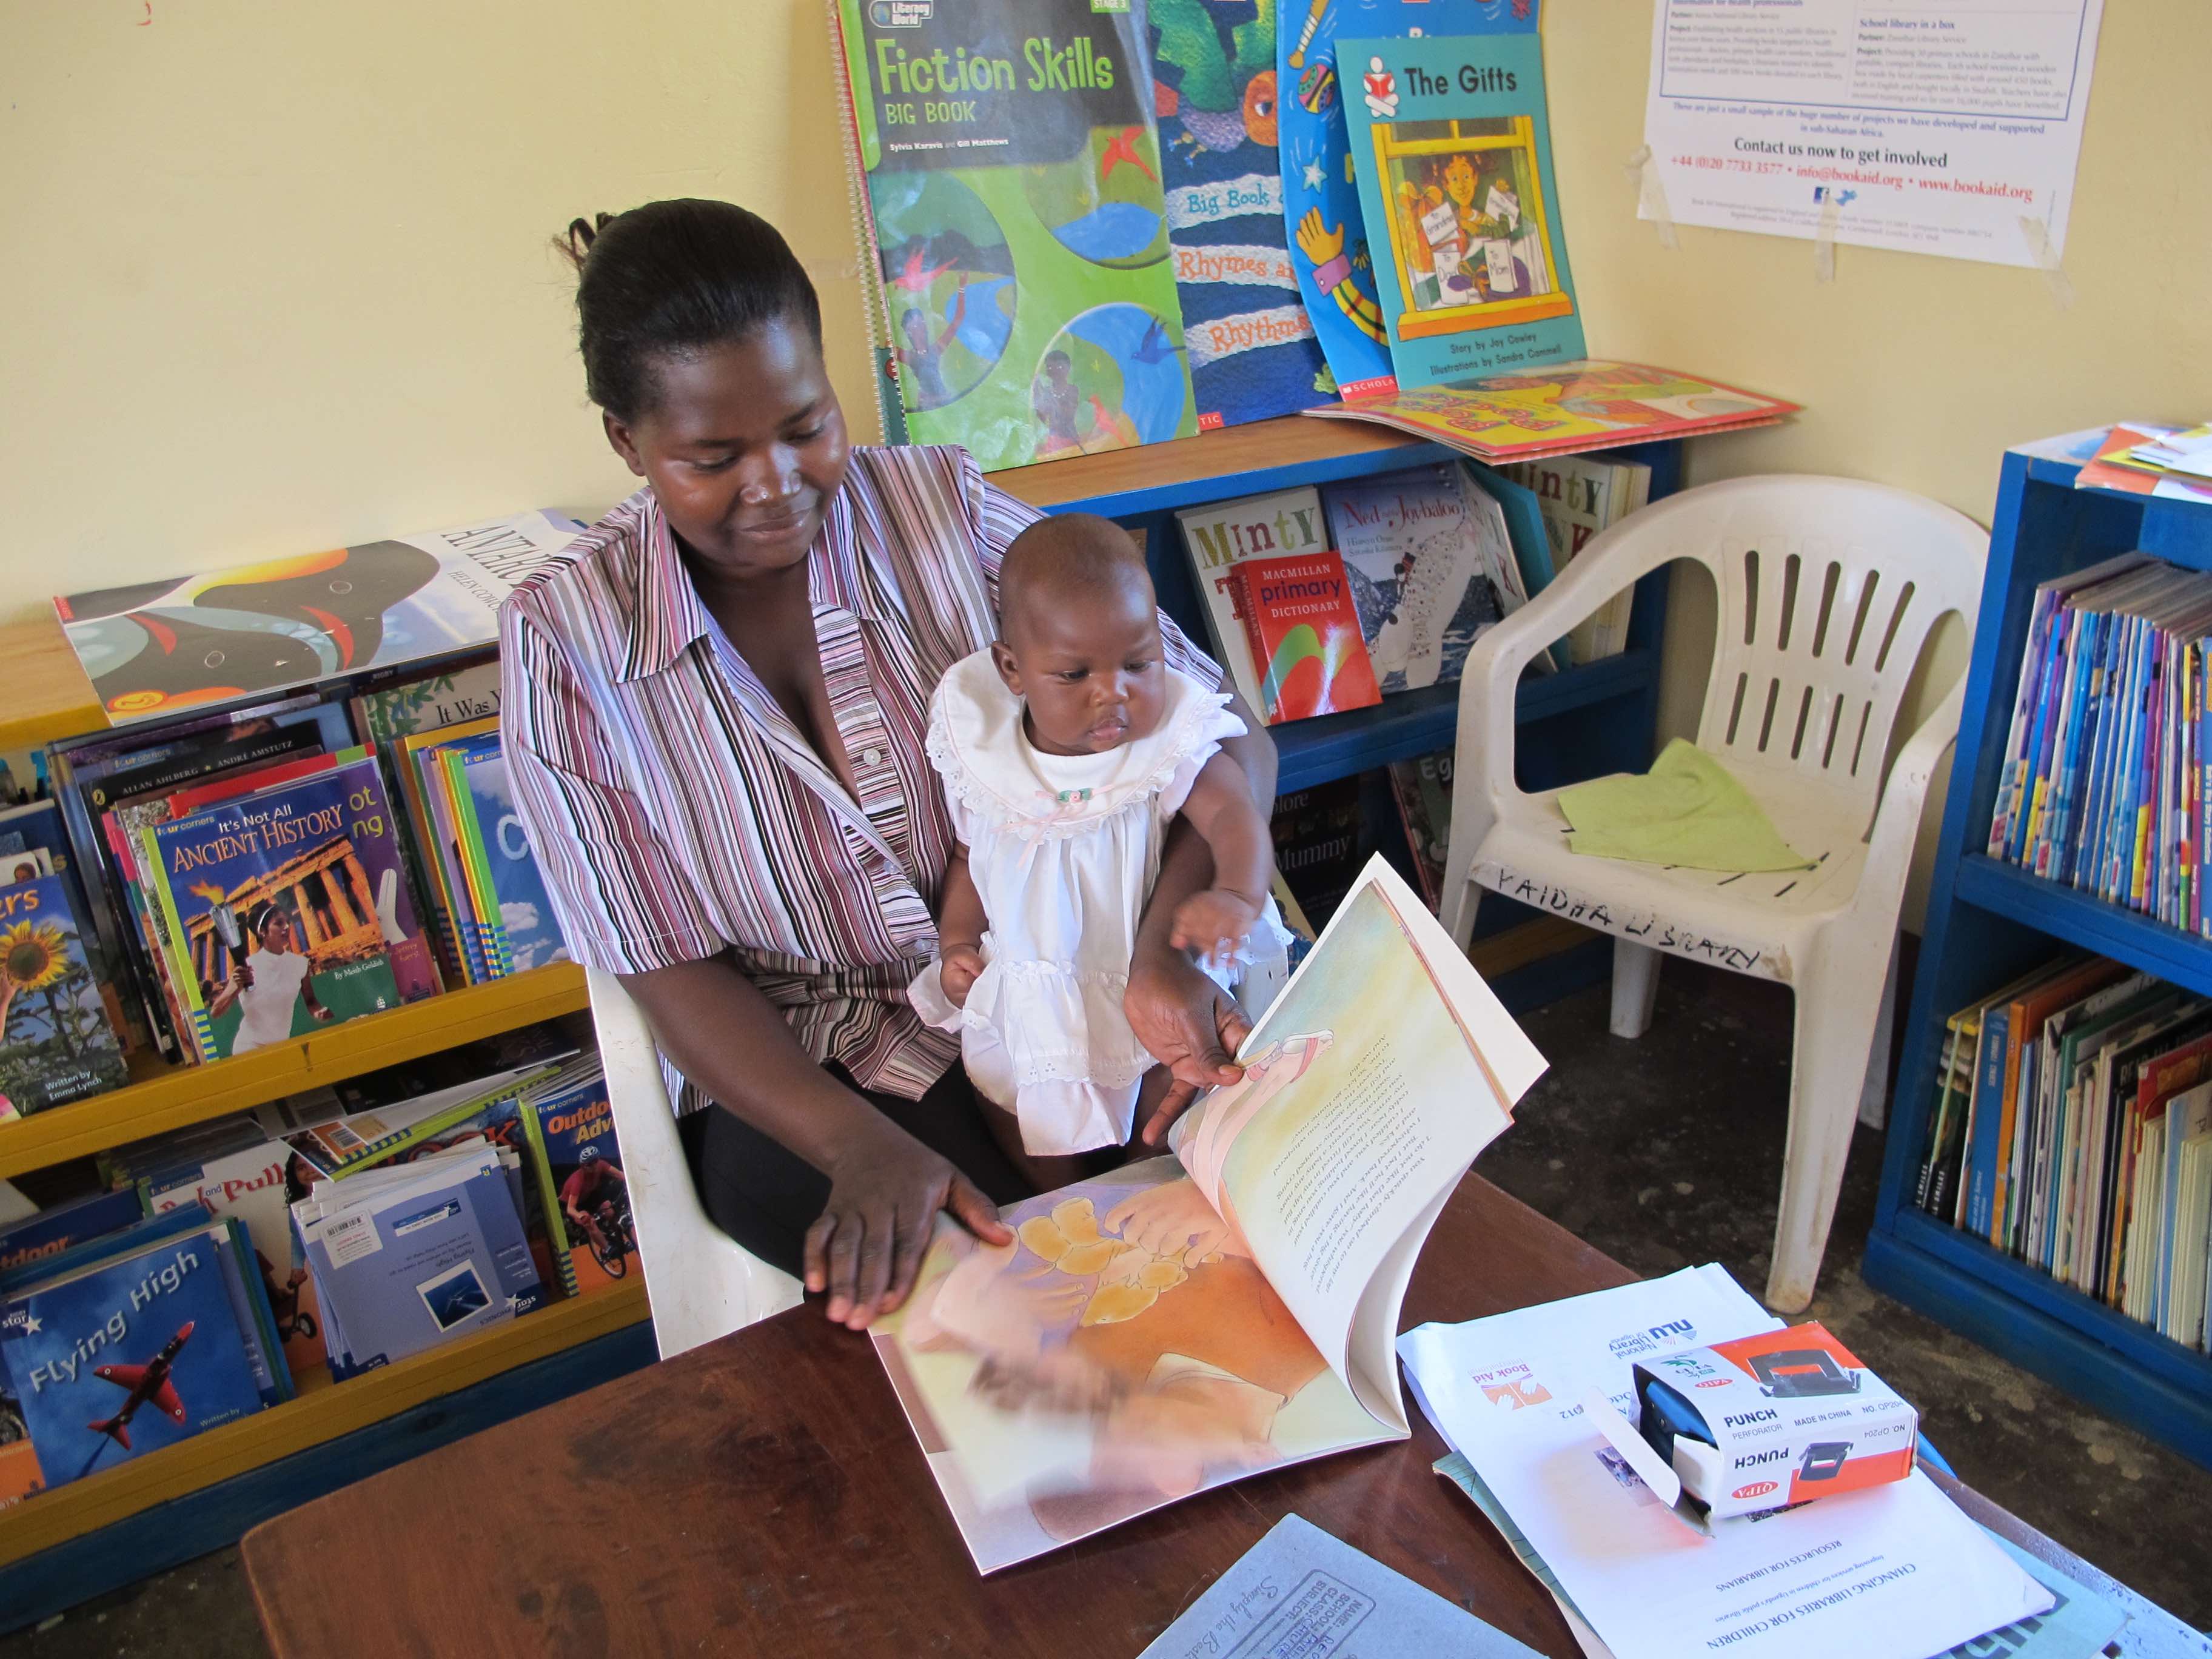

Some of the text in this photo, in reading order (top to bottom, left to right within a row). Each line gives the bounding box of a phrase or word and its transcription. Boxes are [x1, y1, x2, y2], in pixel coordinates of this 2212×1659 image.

[1860, 18, 1888, 28] School
[1890, 19, 1917, 30] library
[1921, 20, 1929, 28] in
[1939, 20, 1956, 30] box
[875, 36, 1115, 95] Fiction Skills
[1404, 63, 1518, 98] The Gifts
[885, 101, 977, 125] BIG BOOK
[890, 142, 913, 152] Sylvia
[1734, 138, 1948, 167] Contact us now to get involved
[1672, 156, 2033, 204] +44 (0)20 7733 3577 info@bookaid.org www.bookaid.org
[1187, 183, 1270, 216] Big Book
[1178, 250, 1269, 283] Rhymes
[1210, 312, 1310, 354] Rhythms
[1450, 333, 1538, 355] Story by Joy Cowley
[1429, 343, 1562, 377] Illustrations by Sandra Cammell
[1339, 499, 1381, 530] Ned
[1262, 563, 1331, 581] MACMILLAN
[1259, 576, 1342, 606] primary
[1271, 600, 1341, 618] DICTIONARY
[436, 698, 490, 725] It Was
[122, 780, 153, 796] ALLAN
[155, 768, 199, 785] AHLBERG
[251, 740, 294, 758] AMSTUTZ
[218, 803, 293, 834] It's Not All
[173, 803, 343, 874] ANCIENT HISTORY
[45, 1070, 92, 1091] Written by
[49, 1076, 102, 1101] Emma Lynch
[1409, 1156, 1426, 1172] You
[205, 1162, 285, 1202] and Pull
[29, 1249, 199, 1393] Flying High
[1608, 1336, 1651, 1353] Library
[1614, 1342, 1658, 1360] National
[1472, 1364, 1530, 1384] Book Aid
[1723, 1408, 1778, 1427] PUNCH
[1794, 1409, 1852, 1427] MADE IN CHINA
[1862, 1399, 1905, 1414] NO. QP204
[1732, 1423, 1783, 1440] PERFORATOR
[1863, 1424, 1906, 1439] NO. QP204
[1734, 1447, 1790, 1470] PUNCH
[1738, 1482, 1774, 1498] QIPA
[1715, 1538, 1843, 1593] RESOURCES FOR LIBRARIANS
[1230, 1575, 1279, 1620] Simply
[1285, 1580, 1327, 1621] SUBJECT:
[1714, 1554, 1885, 1623] Improving services for children in Uganda's public libraries
[1306, 1587, 1339, 1620] CLASS:
[1312, 1593, 1351, 1632] SCHOOL:
[1333, 1600, 1362, 1629] NAME:
[1706, 1563, 1917, 1651] CHANGING LIBRARIES FOR CHILDREN
[1215, 1614, 1236, 1632] the
